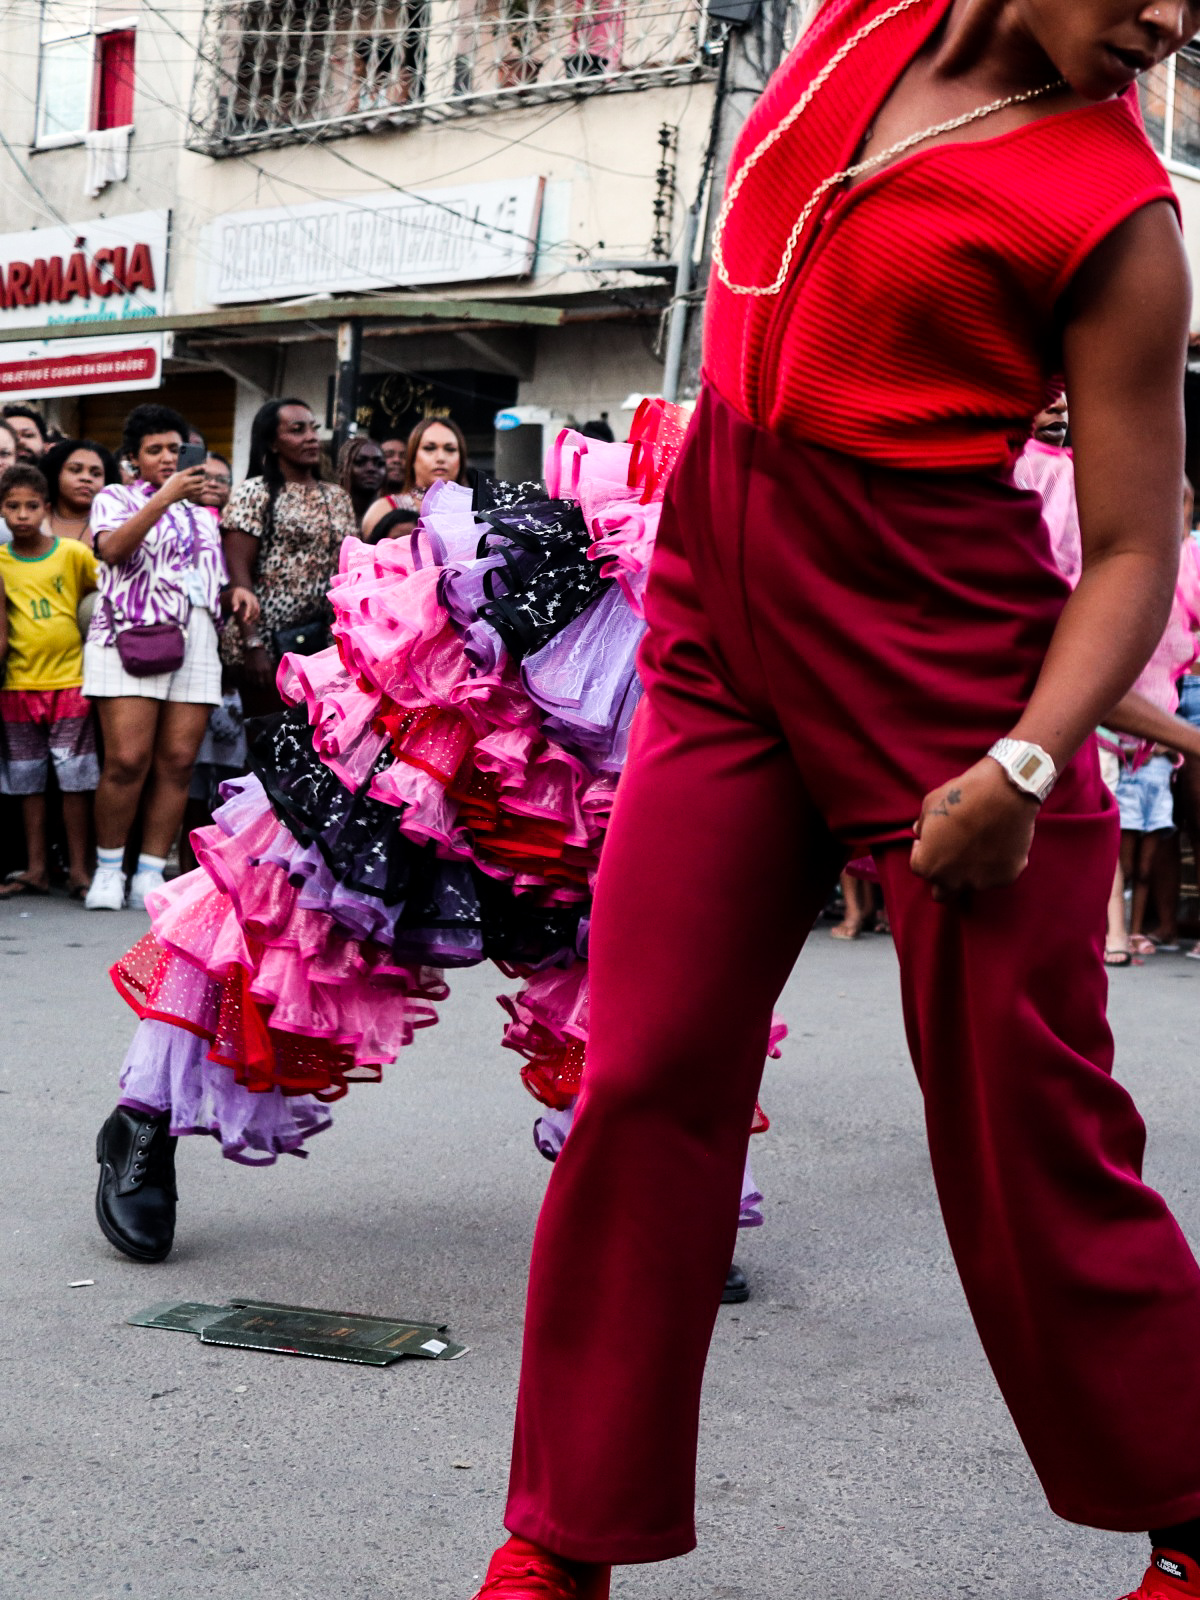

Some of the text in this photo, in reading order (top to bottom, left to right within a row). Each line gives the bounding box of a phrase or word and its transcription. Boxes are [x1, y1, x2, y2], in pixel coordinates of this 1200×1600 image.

[0, 236, 157, 310] RMÁCIA
[218, 212, 340, 293] BARBEARIA
[96, 361, 114, 375] SUA
[30, 598, 51, 620] 10
